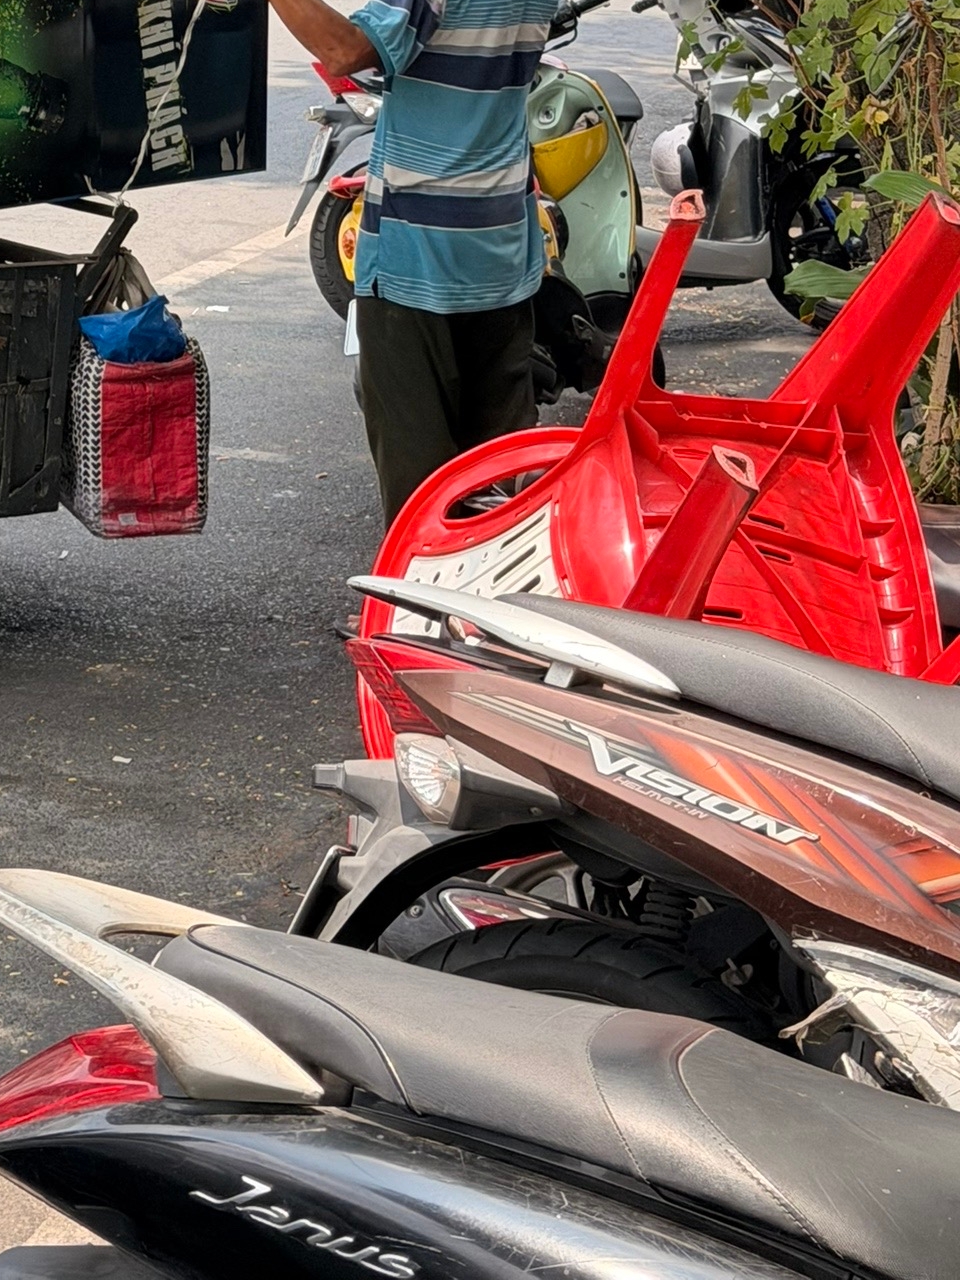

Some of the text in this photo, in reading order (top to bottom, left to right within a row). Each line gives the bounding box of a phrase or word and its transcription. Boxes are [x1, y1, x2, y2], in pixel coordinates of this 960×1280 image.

[138, 0, 181, 61] KHÍ
[143, 61, 188, 172] PHÁCH
[563, 719, 821, 846] VISION
[189, 1174, 419, 1279] Janus
